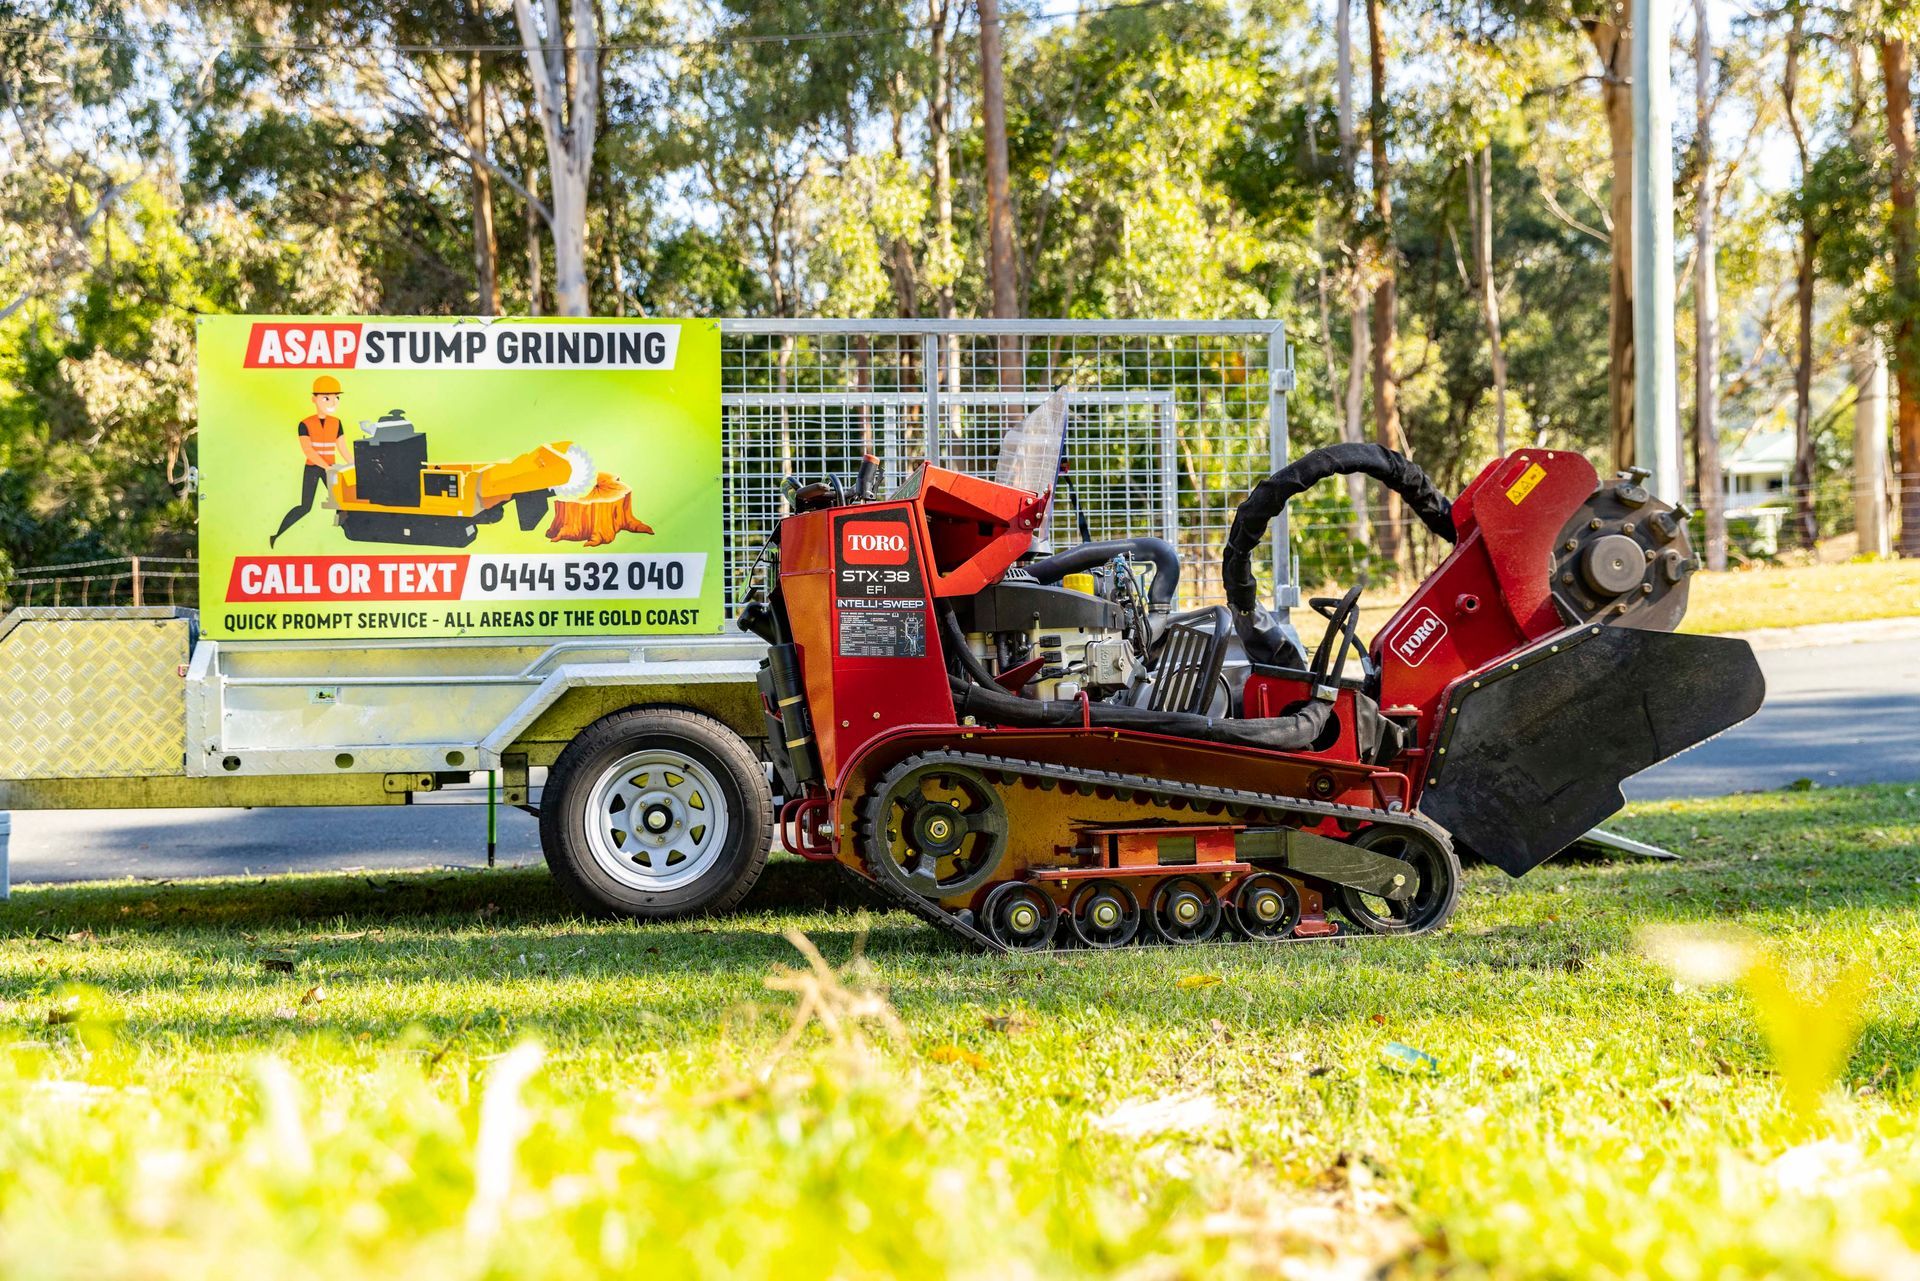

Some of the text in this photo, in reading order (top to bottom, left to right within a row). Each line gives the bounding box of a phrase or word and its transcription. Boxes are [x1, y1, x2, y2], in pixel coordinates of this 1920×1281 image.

[258, 329, 666, 364] ASAP STUMP GRINDING
[848, 534, 904, 551] TORO
[241, 561, 684, 595] CALL OR TEXT 0444 532 040
[866, 585, 887, 594] EFI
[837, 599, 924, 609] INTELLI-SWEEP
[224, 613, 277, 632] QUICK
[282, 612, 353, 630] PROMPT
[357, 611, 427, 629] SERVICE
[444, 611, 475, 628] ALL
[479, 610, 535, 628] AREAS
[538, 609, 559, 627] OF
[563, 609, 595, 627] THE
[599, 608, 642, 627] GOLD
[646, 608, 700, 626] COAST
[1400, 618, 1437, 657] TORO
